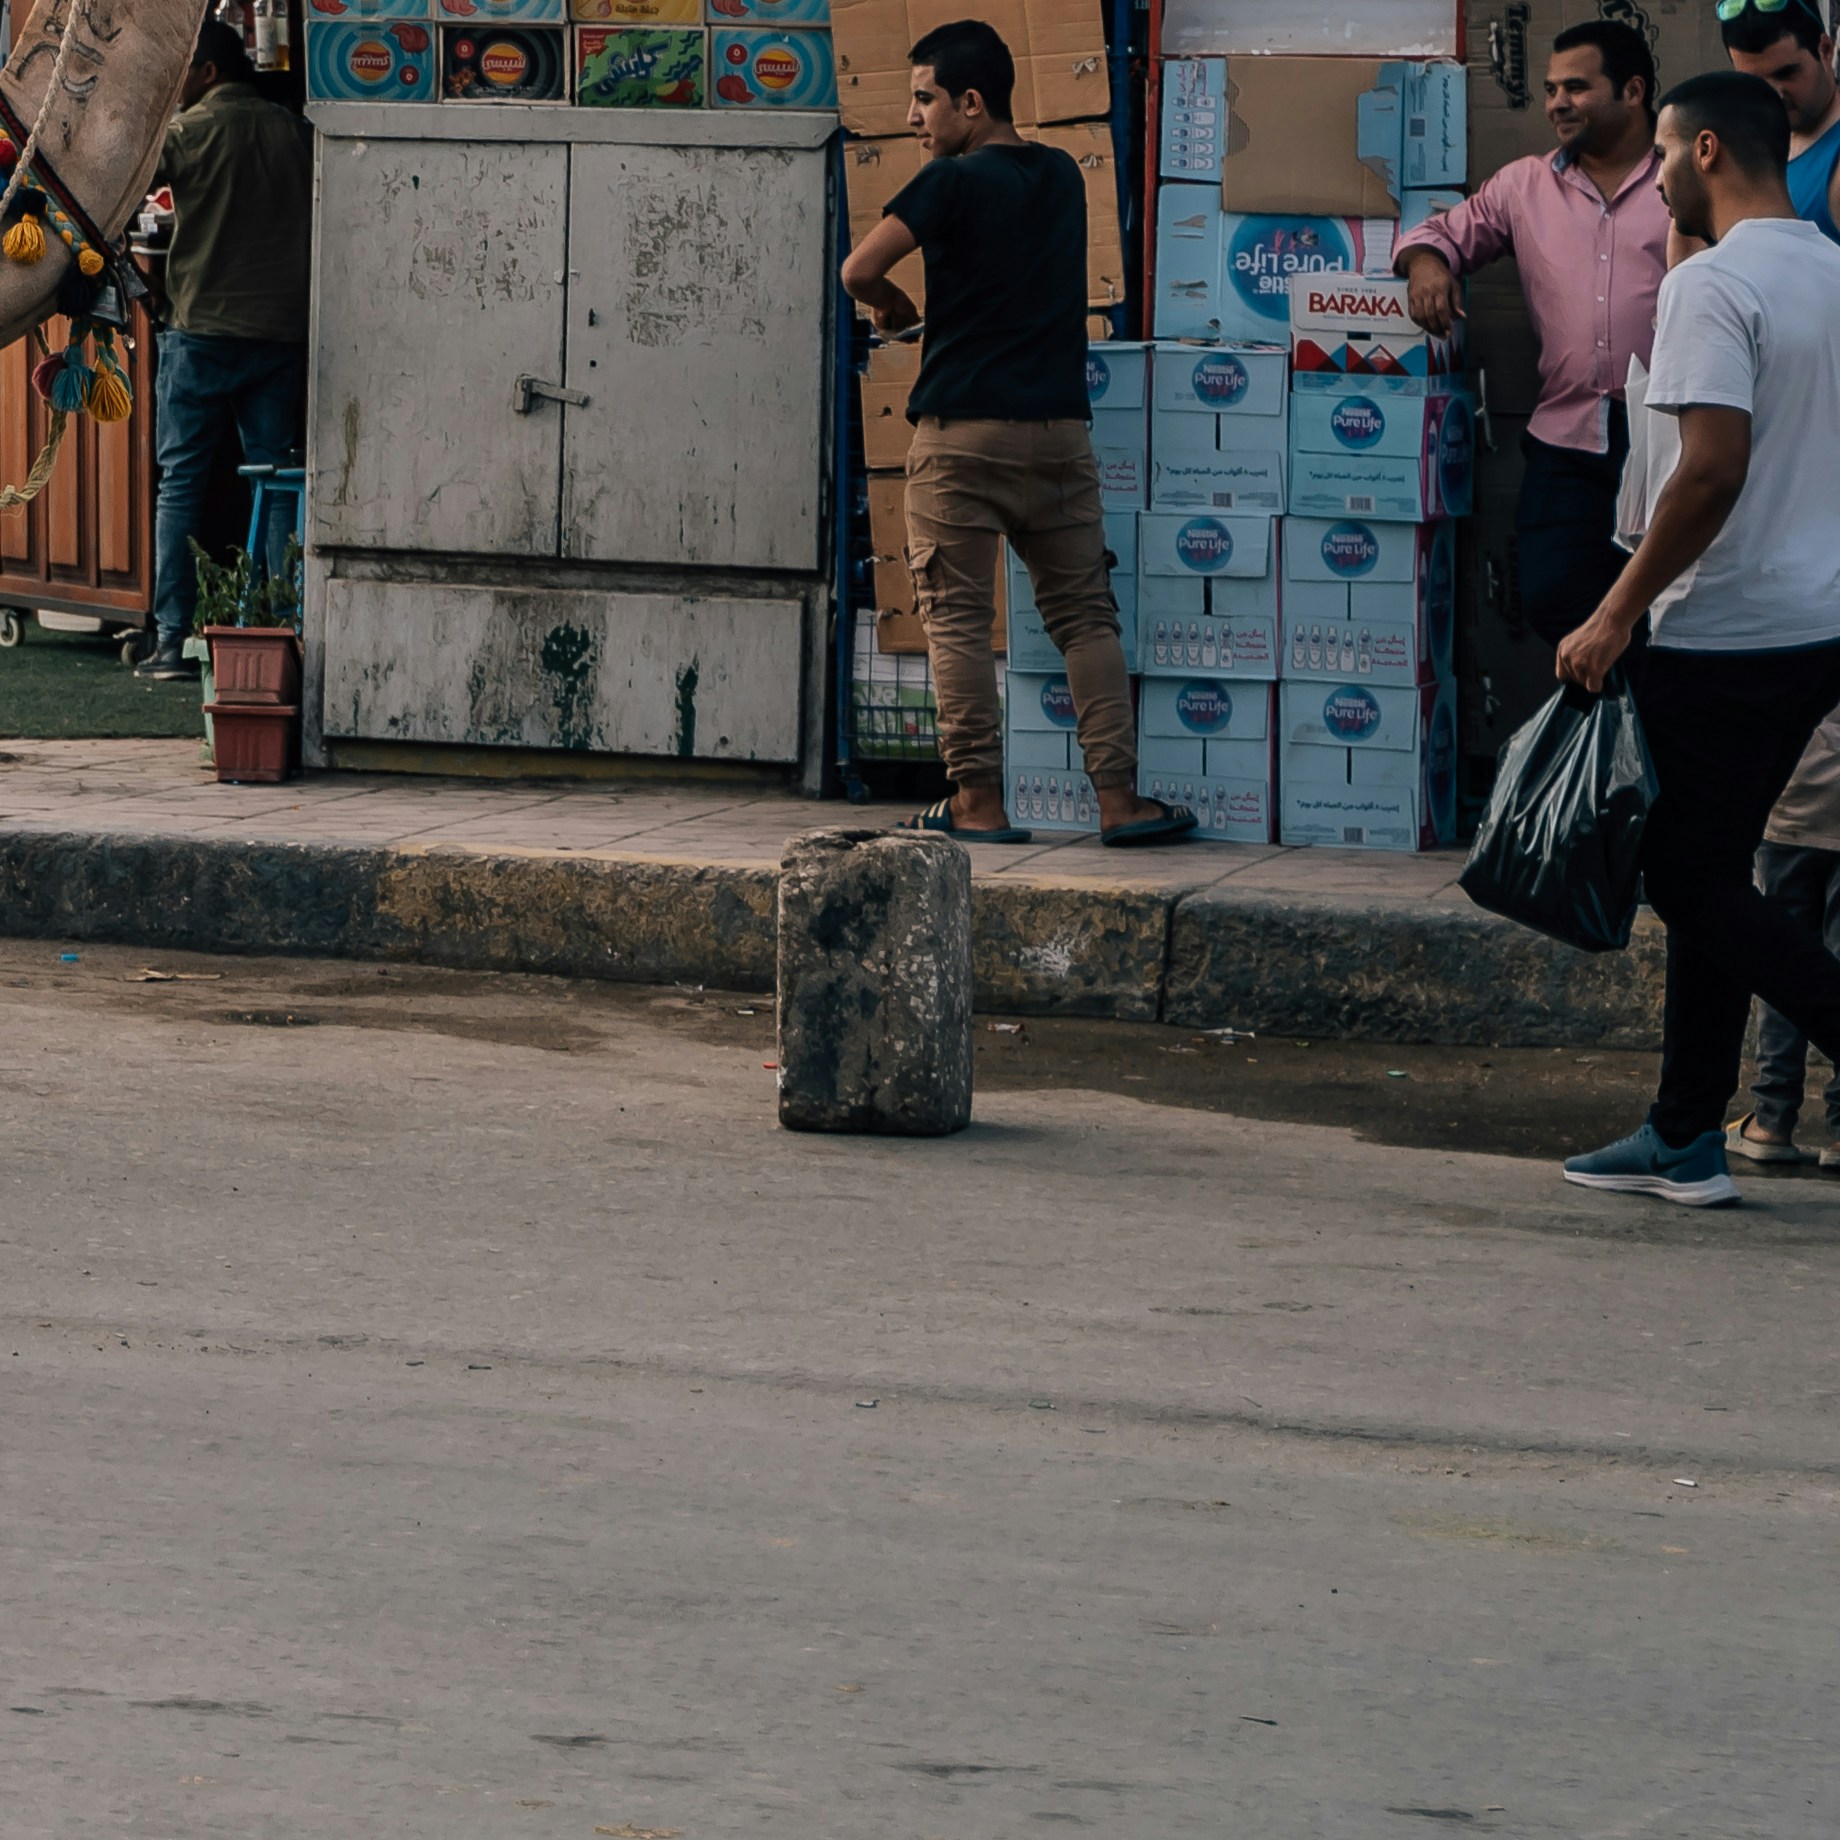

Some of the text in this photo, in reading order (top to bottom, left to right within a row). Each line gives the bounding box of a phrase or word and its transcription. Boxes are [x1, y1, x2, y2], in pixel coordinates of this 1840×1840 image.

[1236, 243, 1345, 276] Pure Life
[1309, 291, 1405, 318] BARAKA
[1086, 368, 1106, 386] Life
[1194, 371, 1246, 391] Pure Life
[1333, 415, 1382, 432] Pure Life
[1178, 535, 1230, 555] Pure Life
[1323, 541, 1376, 559] Pure Life
[1043, 692, 1071, 706] Pure
[1178, 697, 1229, 716] Pure Life
[1326, 705, 1378, 724] Pure Life
